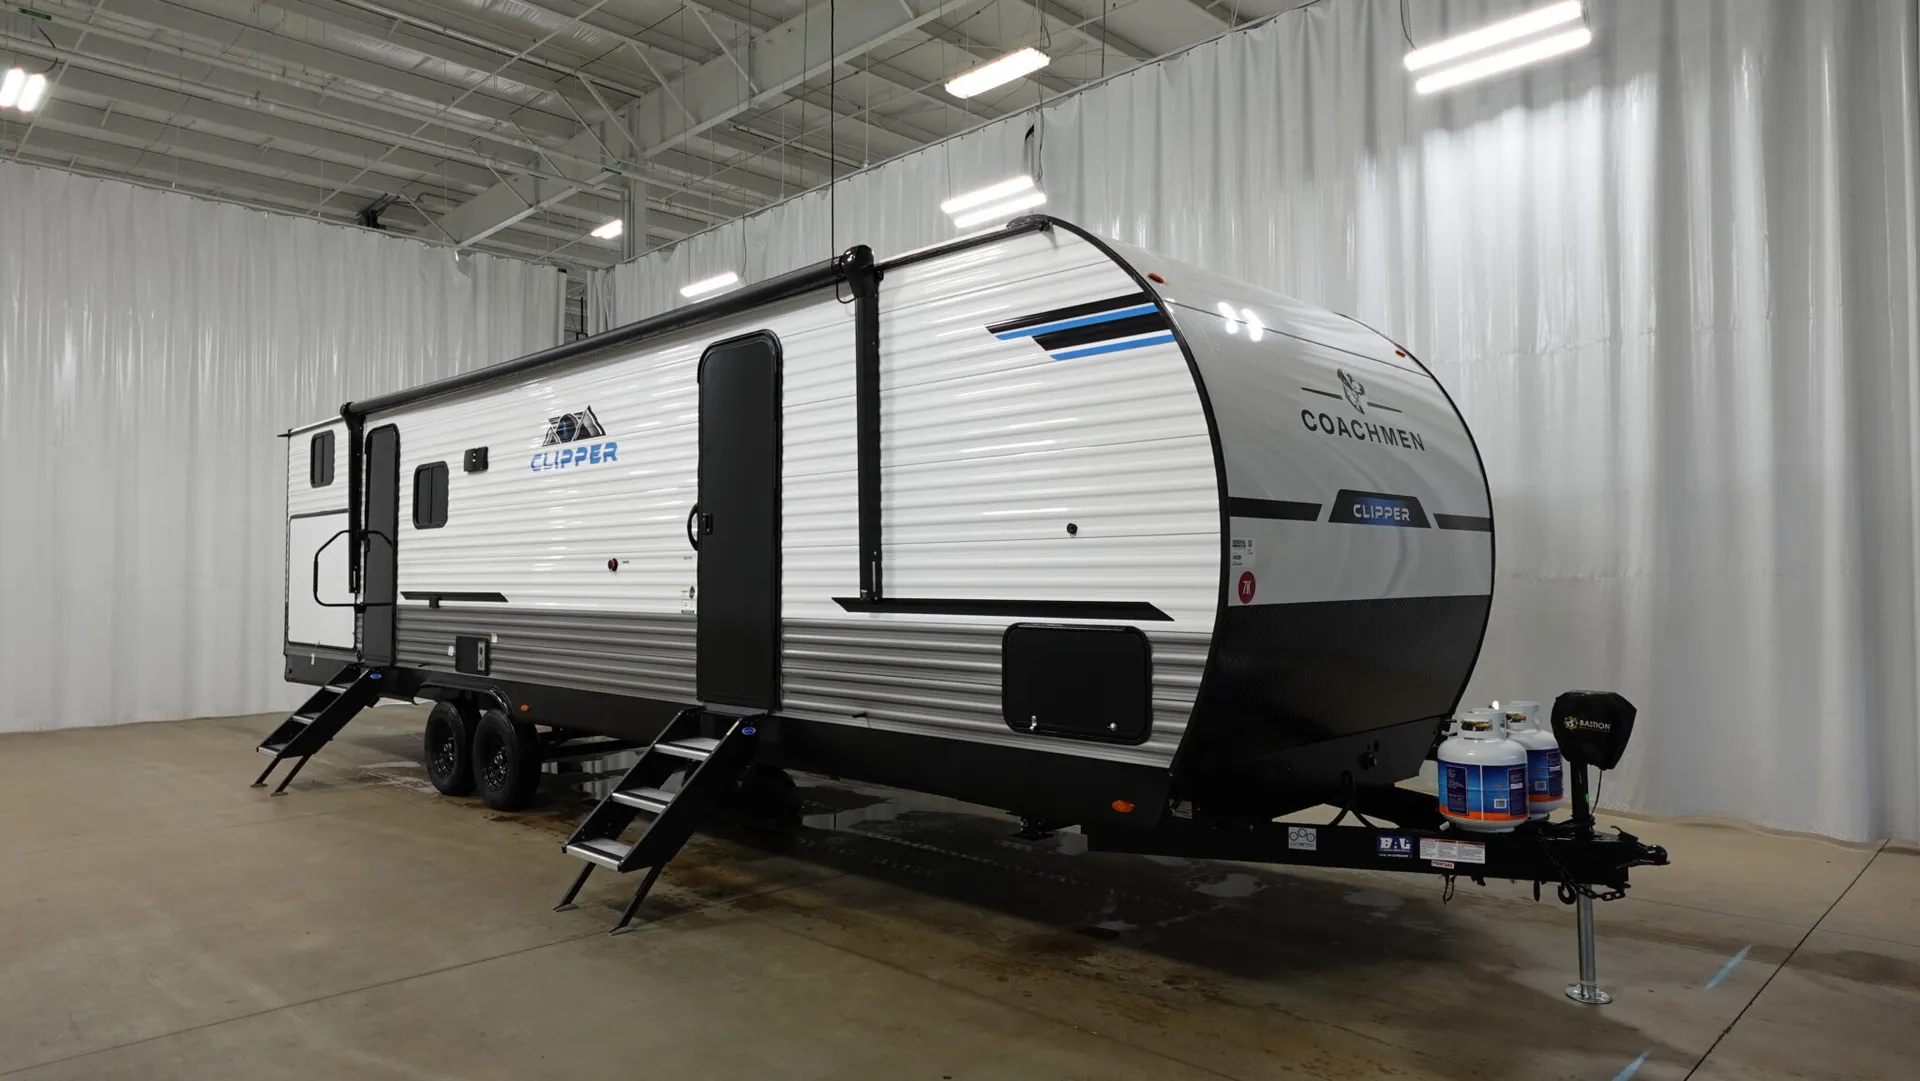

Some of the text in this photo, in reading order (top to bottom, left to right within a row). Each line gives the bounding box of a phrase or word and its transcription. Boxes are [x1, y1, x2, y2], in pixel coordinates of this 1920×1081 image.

[1301, 409, 1425, 451] COACHMEN
[530, 442, 618, 471] CLIPPER
[1353, 504, 1410, 521] CLIPPER
[1579, 719, 1611, 730] BASTION
